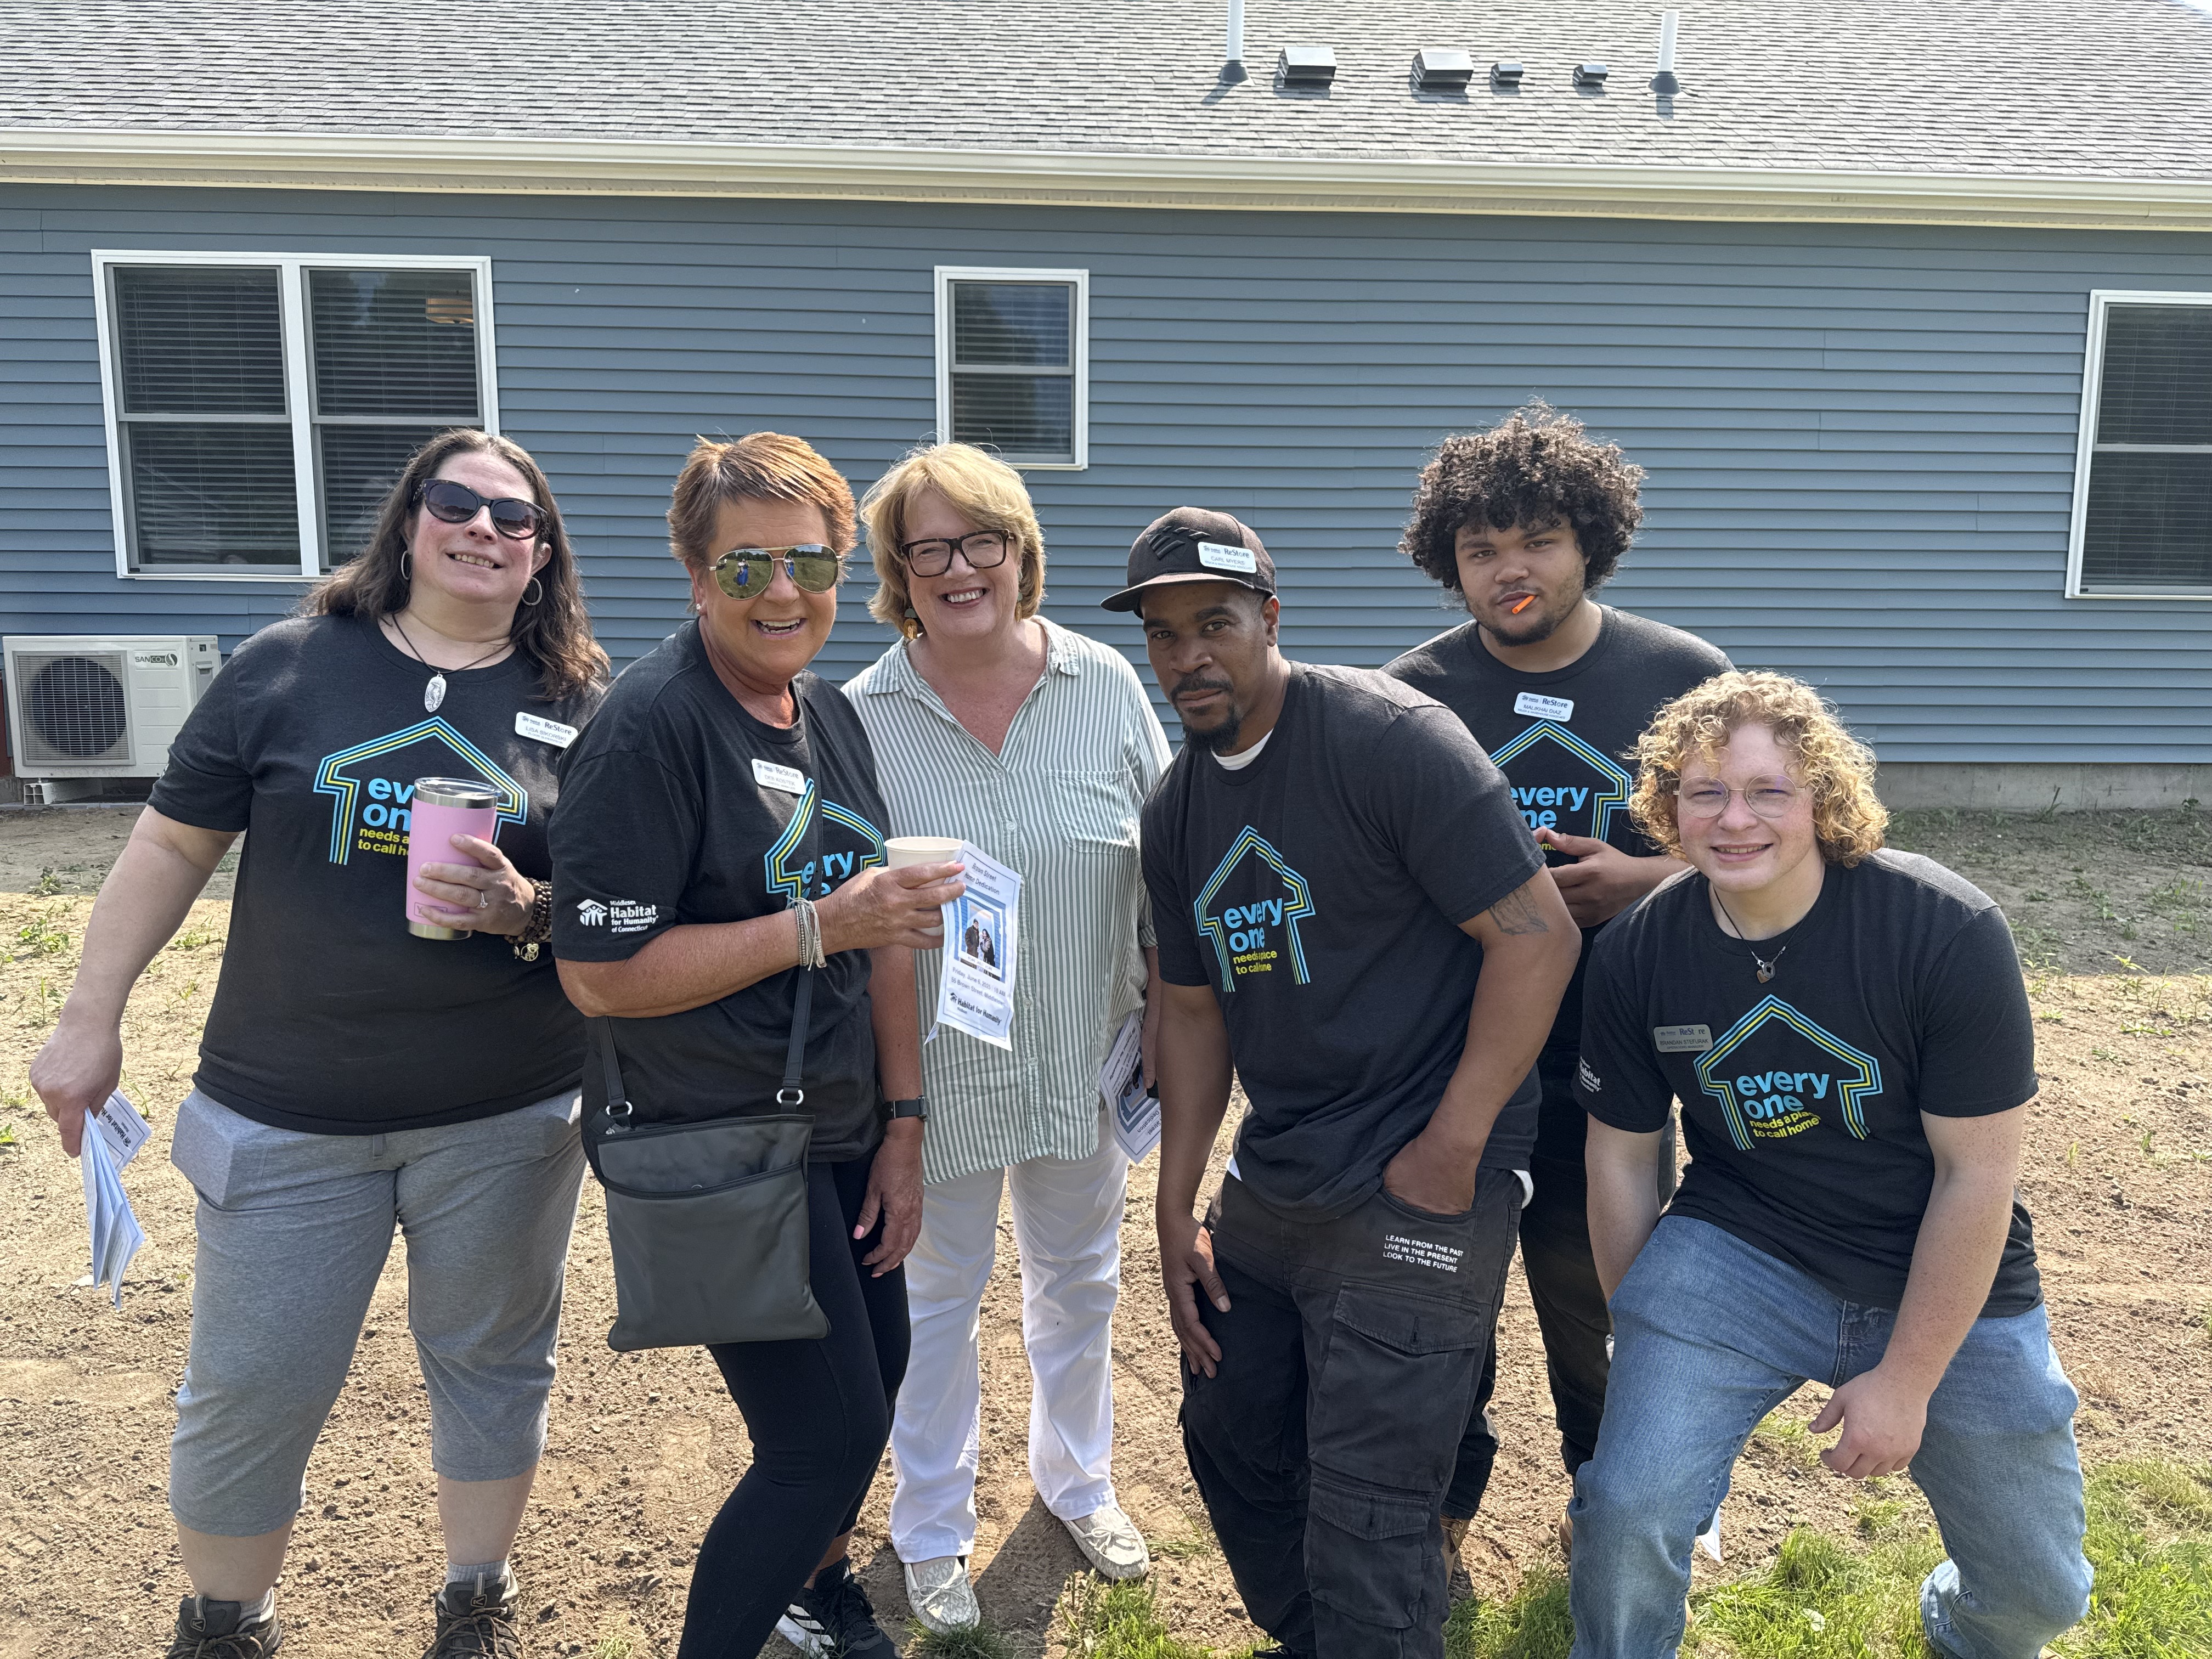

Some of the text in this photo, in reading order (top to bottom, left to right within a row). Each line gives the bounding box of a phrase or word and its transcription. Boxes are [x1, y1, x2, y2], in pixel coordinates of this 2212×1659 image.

[1224, 548, 1250, 558] ReStore
[1542, 698, 1567, 708] ReStore
[545, 722, 572, 735] ReStore
[775, 766, 799, 778] ReStore
[363, 803, 411, 832] on
[1520, 810, 1557, 829] ne
[359, 828, 410, 844] needs a
[358, 839, 371, 850] to
[373, 843, 396, 854] call
[802, 851, 854, 884] ery
[984, 870, 996, 882] Street
[975, 878, 1000, 895] Dedication
[610, 904, 657, 918] Habitat
[1224, 898, 1283, 929] every
[1229, 927, 1265, 952] one
[1233, 951, 1258, 964] needs
[1235, 966, 1248, 974] to
[957, 998, 975, 1012] Habitat
[983, 1009, 1002, 1026] Humanity
[1736, 1071, 1830, 1099] every
[1743, 1094, 1804, 1119] one
[111, 1120, 126, 1139] Habitat
[1137, 1110, 1160, 1133] Dedication
[1749, 1118, 1784, 1128] needs
[1784, 1115, 1791, 1124] a
[1753, 1117, 1819, 1138] to call home
[1384, 1243, 1400, 1251] LIVE
[1411, 1248, 1425, 1257] THE
[1427, 1251, 1458, 1264] PRESENT
[1385, 1234, 1464, 1257] LEARN FROM THE PAST
[1383, 1251, 1403, 1261] LOOK
[1417, 1257, 1431, 1266] THE
[1433, 1261, 1458, 1273] FUTURE
